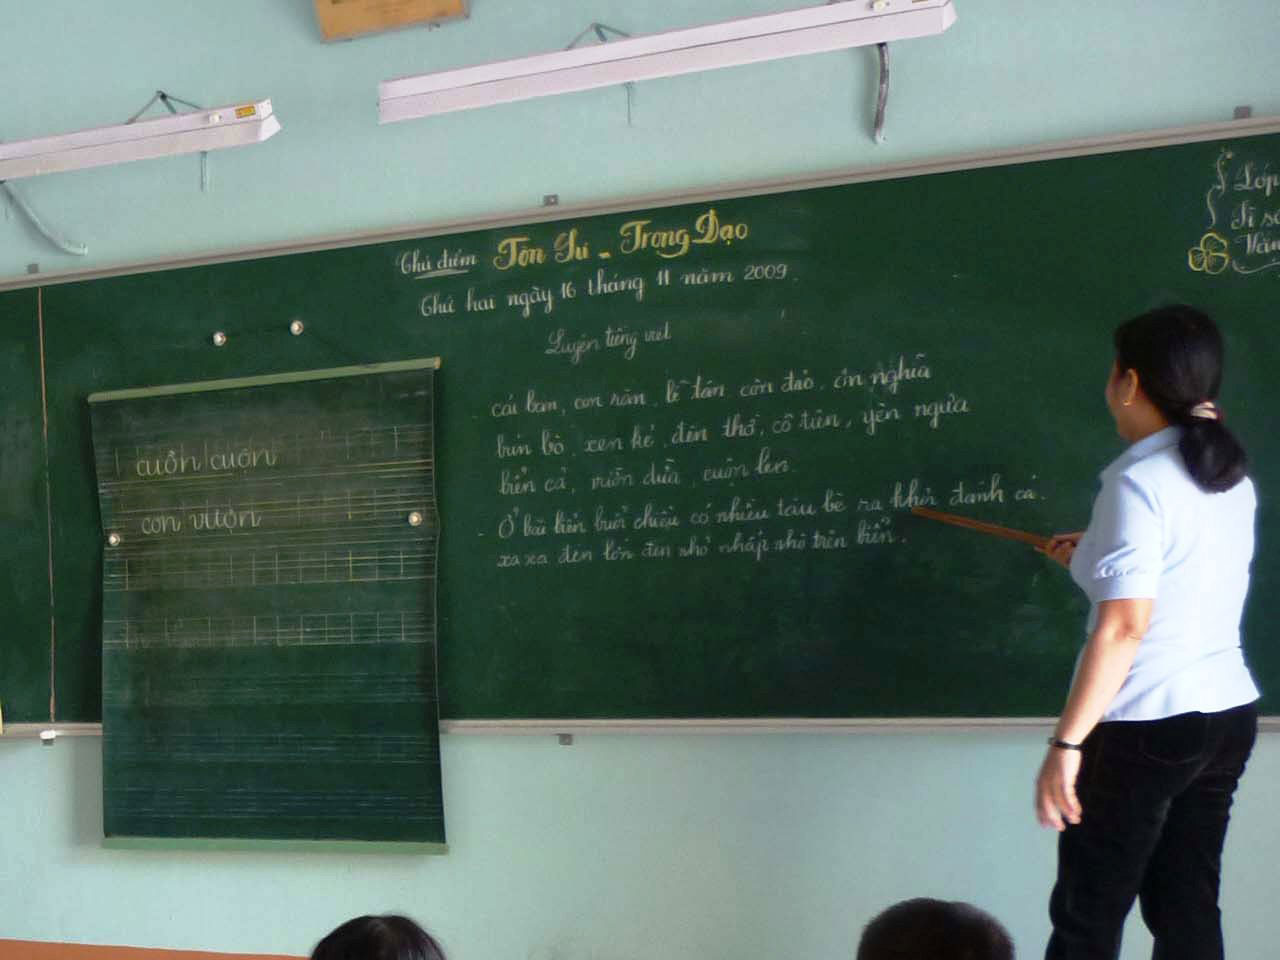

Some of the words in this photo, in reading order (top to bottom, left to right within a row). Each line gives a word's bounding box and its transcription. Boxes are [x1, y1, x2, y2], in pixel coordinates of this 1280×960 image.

[466, 288, 497, 313] hai
[562, 281, 577, 299] 16
[587, 268, 645, 303] tháng
[658, 269, 671, 286] 11
[141, 514, 182, 535] con
